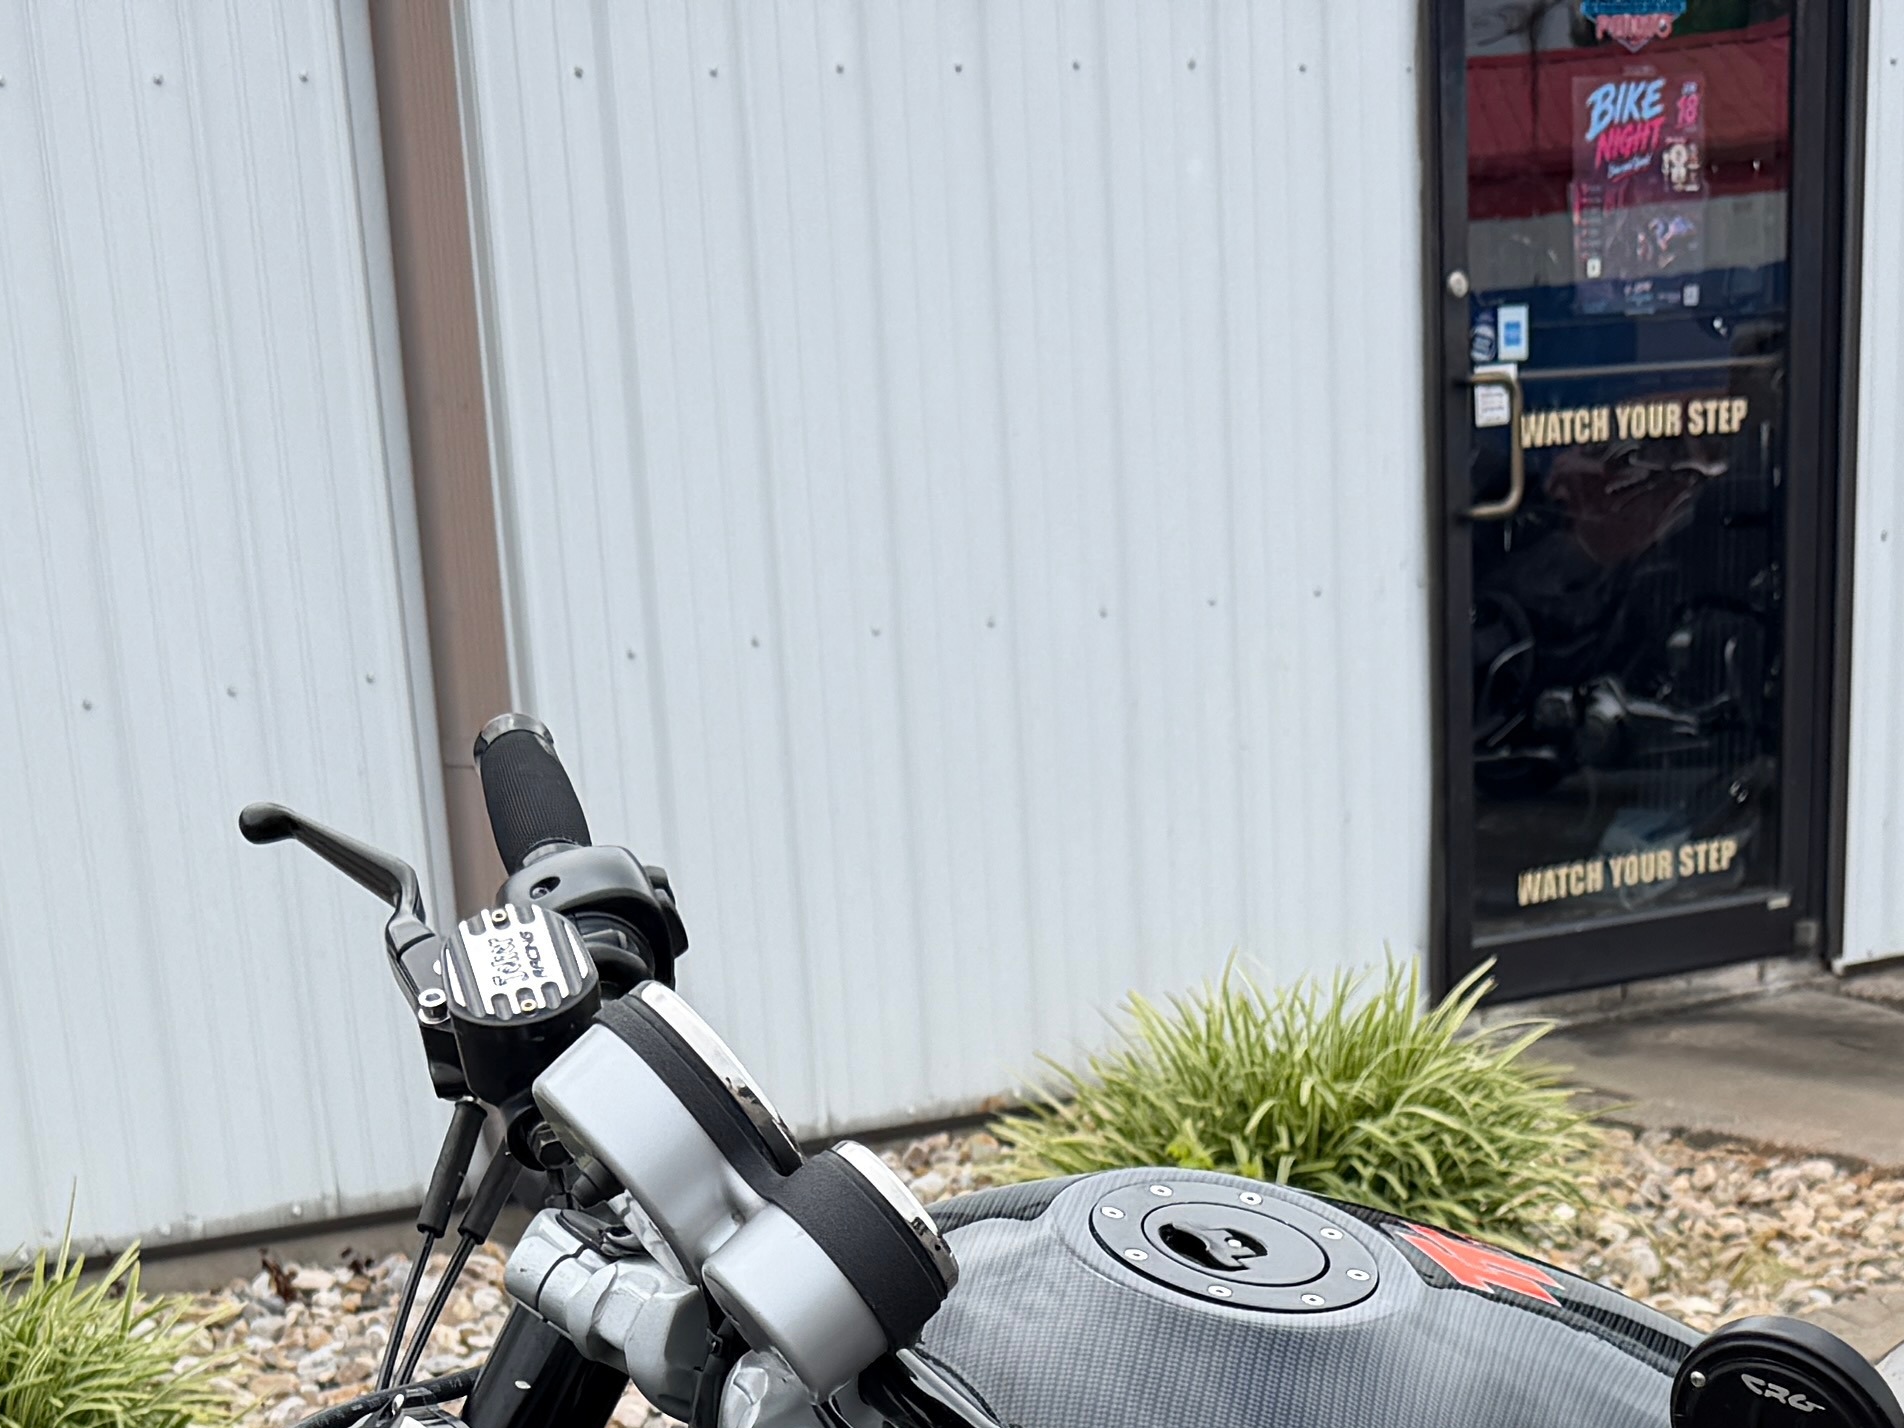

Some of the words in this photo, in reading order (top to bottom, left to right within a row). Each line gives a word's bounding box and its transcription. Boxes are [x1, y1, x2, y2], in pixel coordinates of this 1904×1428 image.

[1584, 78, 1667, 142] BIKE
[1595, 116, 1666, 168] NIGHT
[1520, 406, 1610, 449] WATCH
[1615, 402, 1683, 440] YOUR
[1687, 398, 1748, 436] STEP
[1517, 859, 1605, 907] WATCH
[1609, 849, 1674, 888] YOUR
[1678, 839, 1738, 877] STEP
[1741, 1373, 1826, 1412] CRG
